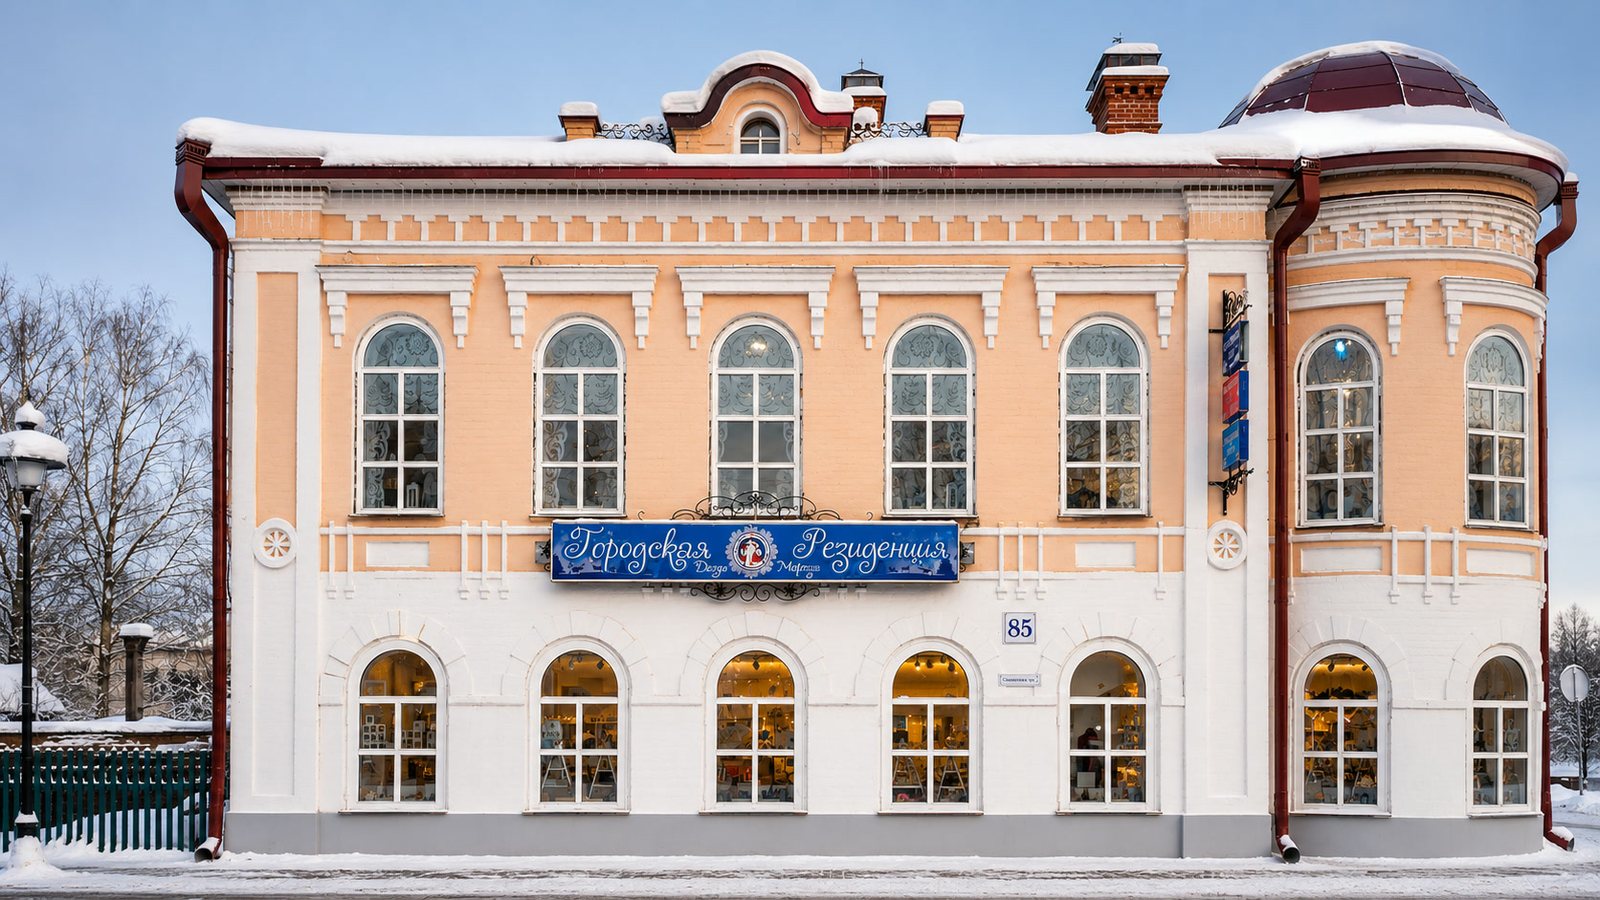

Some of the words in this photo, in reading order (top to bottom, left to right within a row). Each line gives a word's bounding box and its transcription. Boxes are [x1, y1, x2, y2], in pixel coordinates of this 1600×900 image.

[564, 526, 712, 574] Городская
[792, 527, 950, 574] Резиденция
[1008, 618, 1032, 638] 85
